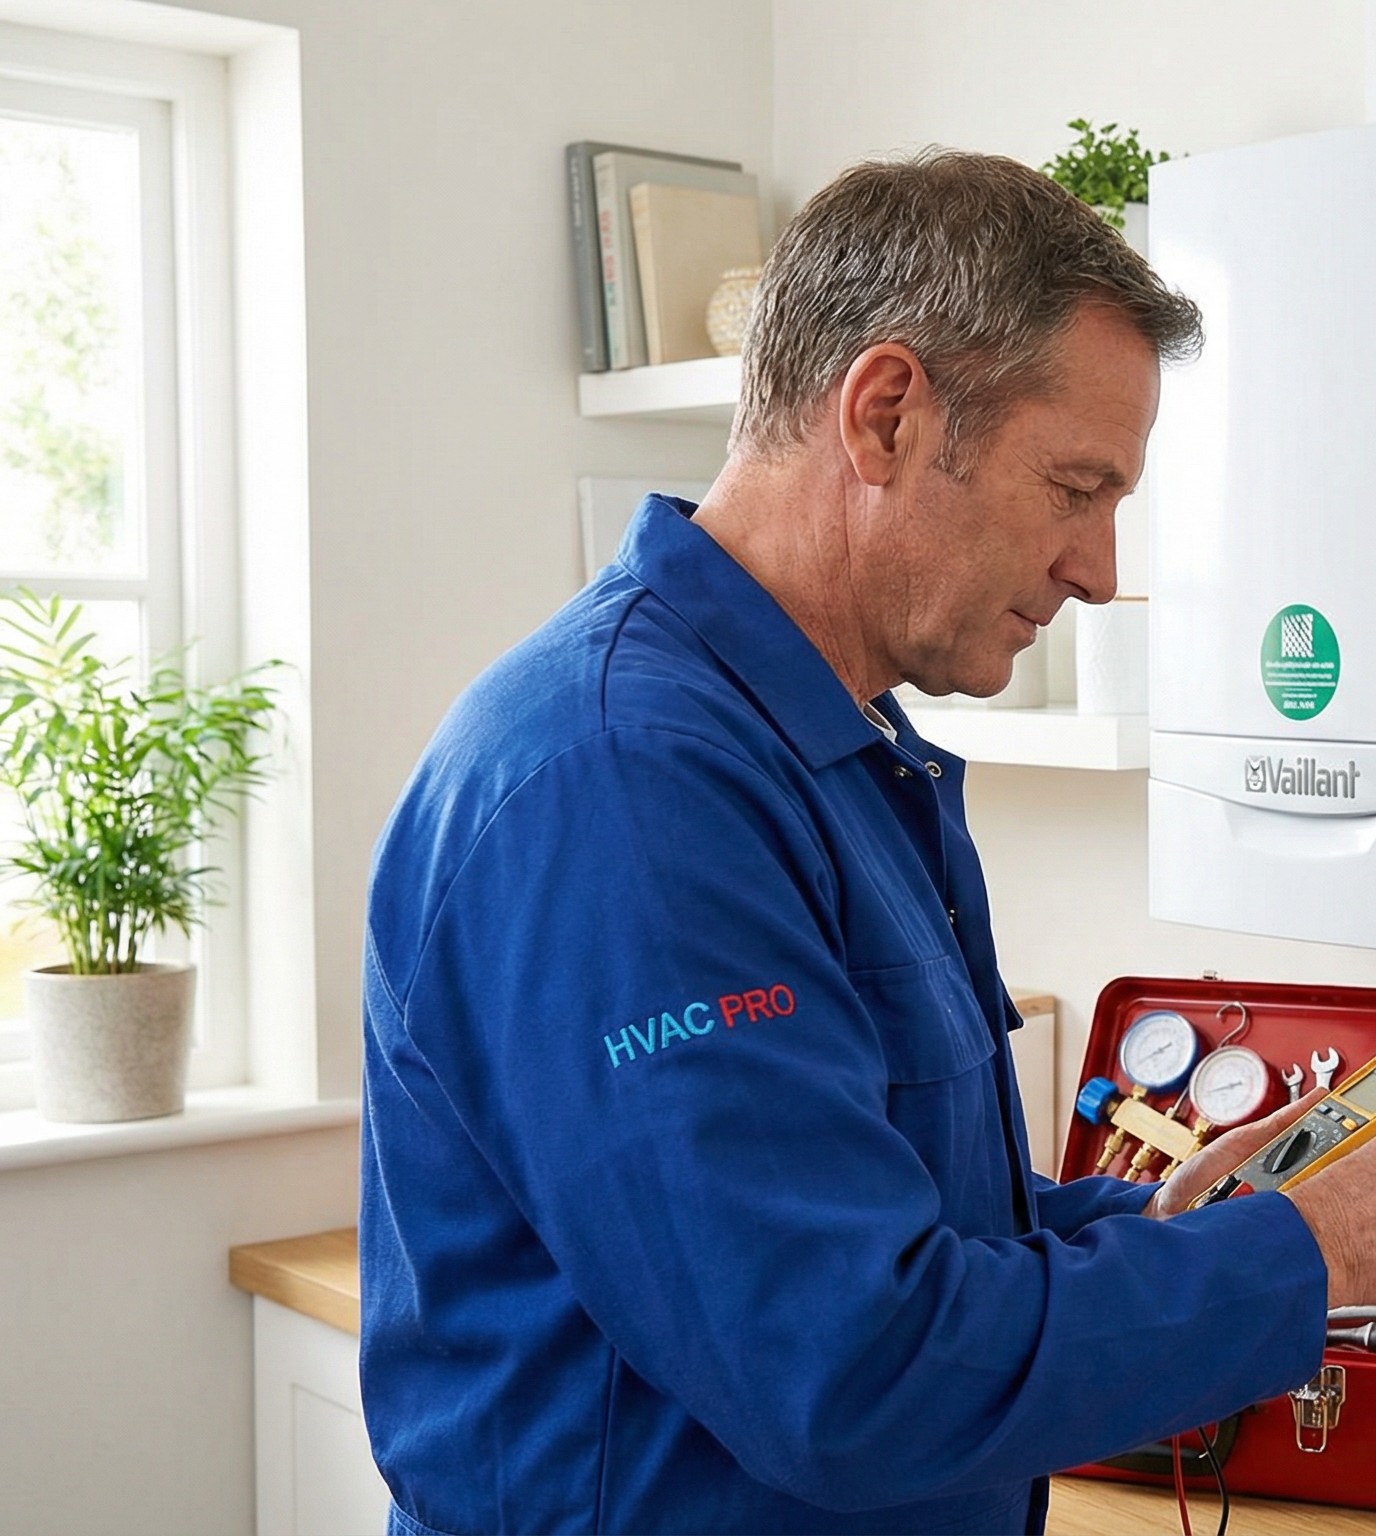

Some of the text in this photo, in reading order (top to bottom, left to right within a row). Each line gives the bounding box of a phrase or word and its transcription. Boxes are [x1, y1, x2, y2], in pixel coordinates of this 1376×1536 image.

[1267, 756, 1360, 799] Vaillant
[604, 984, 795, 1068] HVAC PRO
